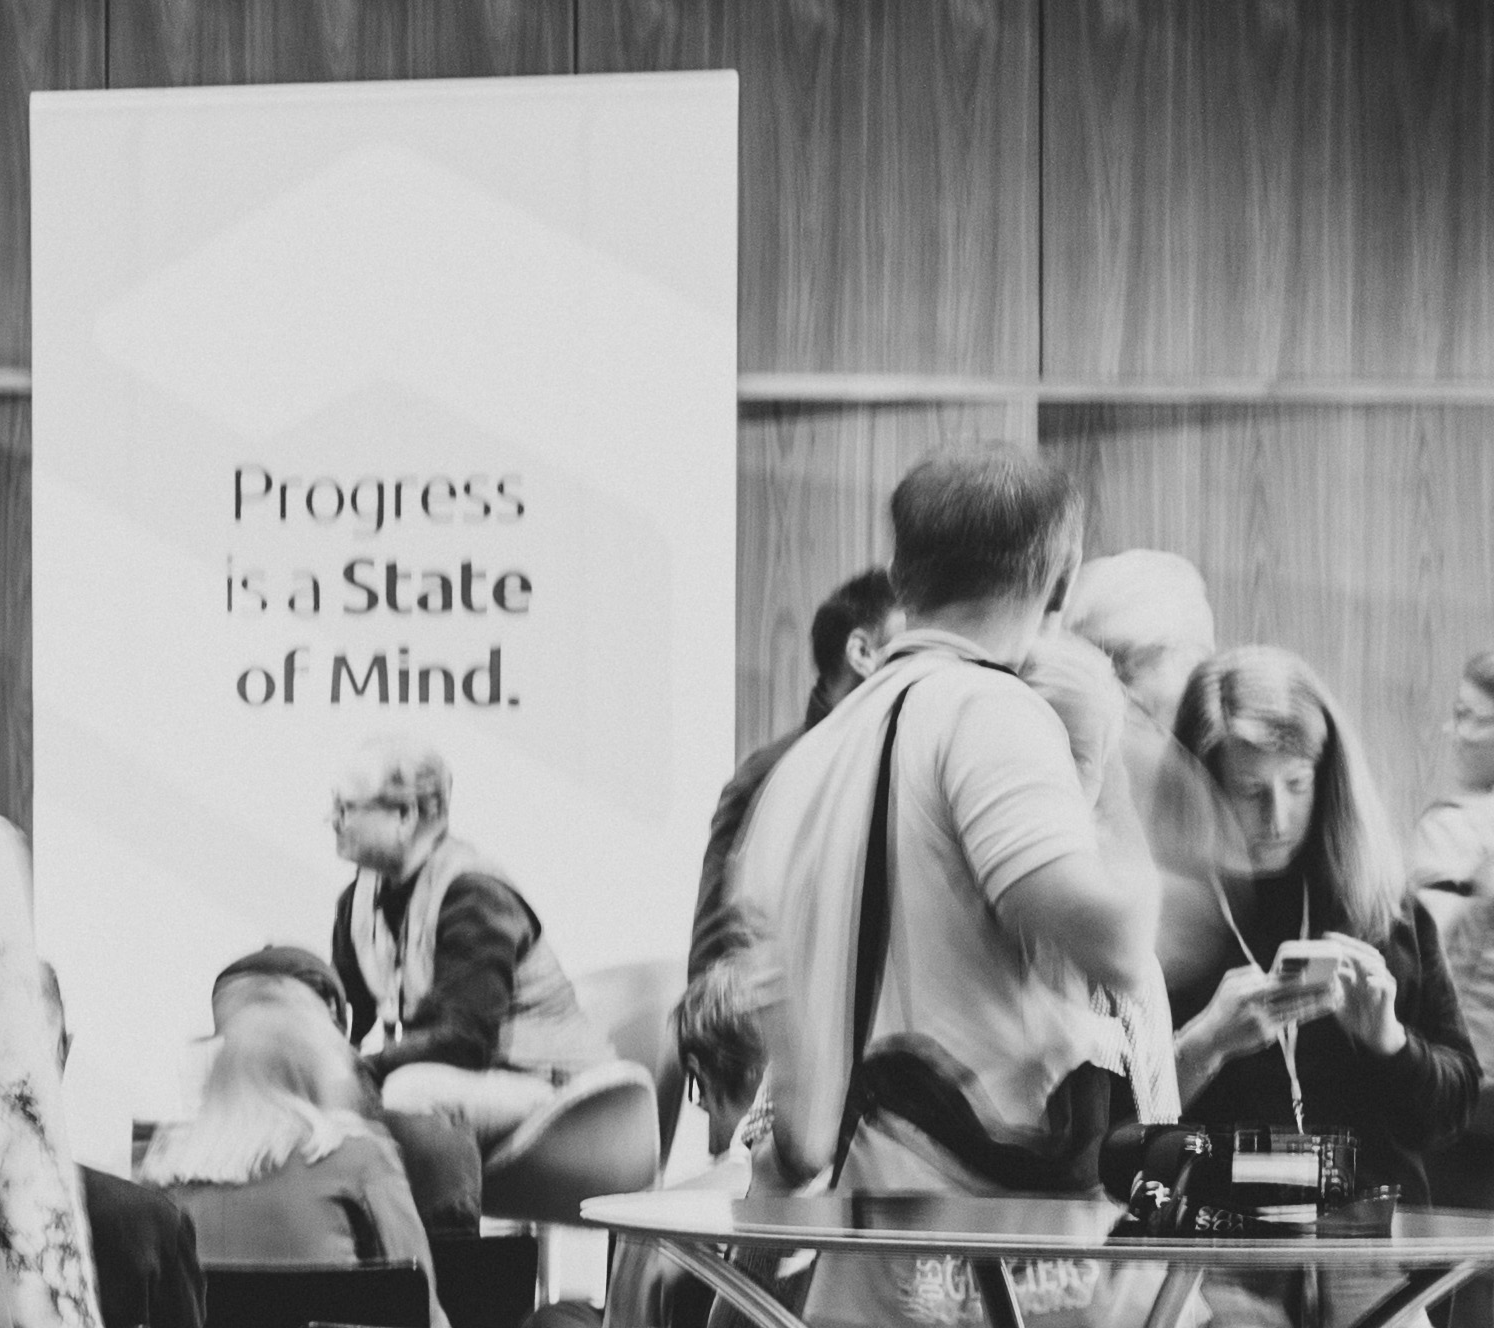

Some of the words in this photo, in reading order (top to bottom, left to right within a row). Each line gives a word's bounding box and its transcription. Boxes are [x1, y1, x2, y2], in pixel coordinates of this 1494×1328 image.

[232, 463, 526, 538] Progress
[225, 554, 269, 615] is
[286, 572, 322, 616] a
[341, 556, 534, 617] State
[234, 645, 310, 708] of
[328, 642, 522, 710] Mind.
